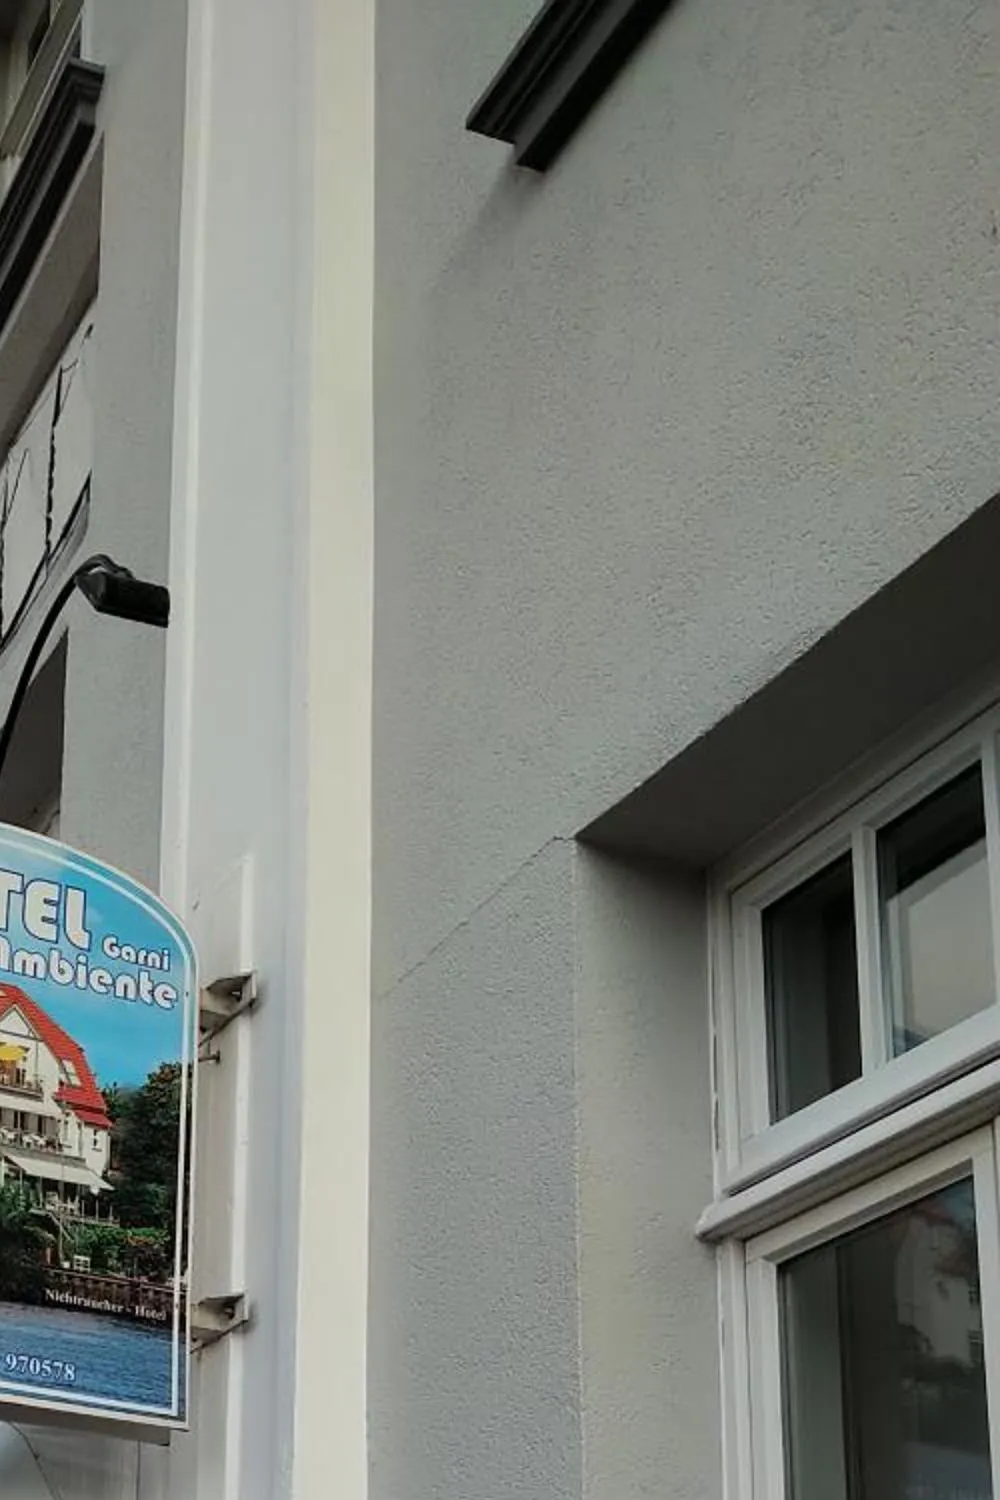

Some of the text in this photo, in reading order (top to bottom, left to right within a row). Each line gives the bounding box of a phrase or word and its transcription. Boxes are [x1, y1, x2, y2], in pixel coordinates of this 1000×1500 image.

[102, 935, 171, 971] Garni
[45, 1288, 124, 1313] Nichtraucher
[135, 1305, 167, 1321] Hotel
[5, 1353, 76, 1381] 970578
